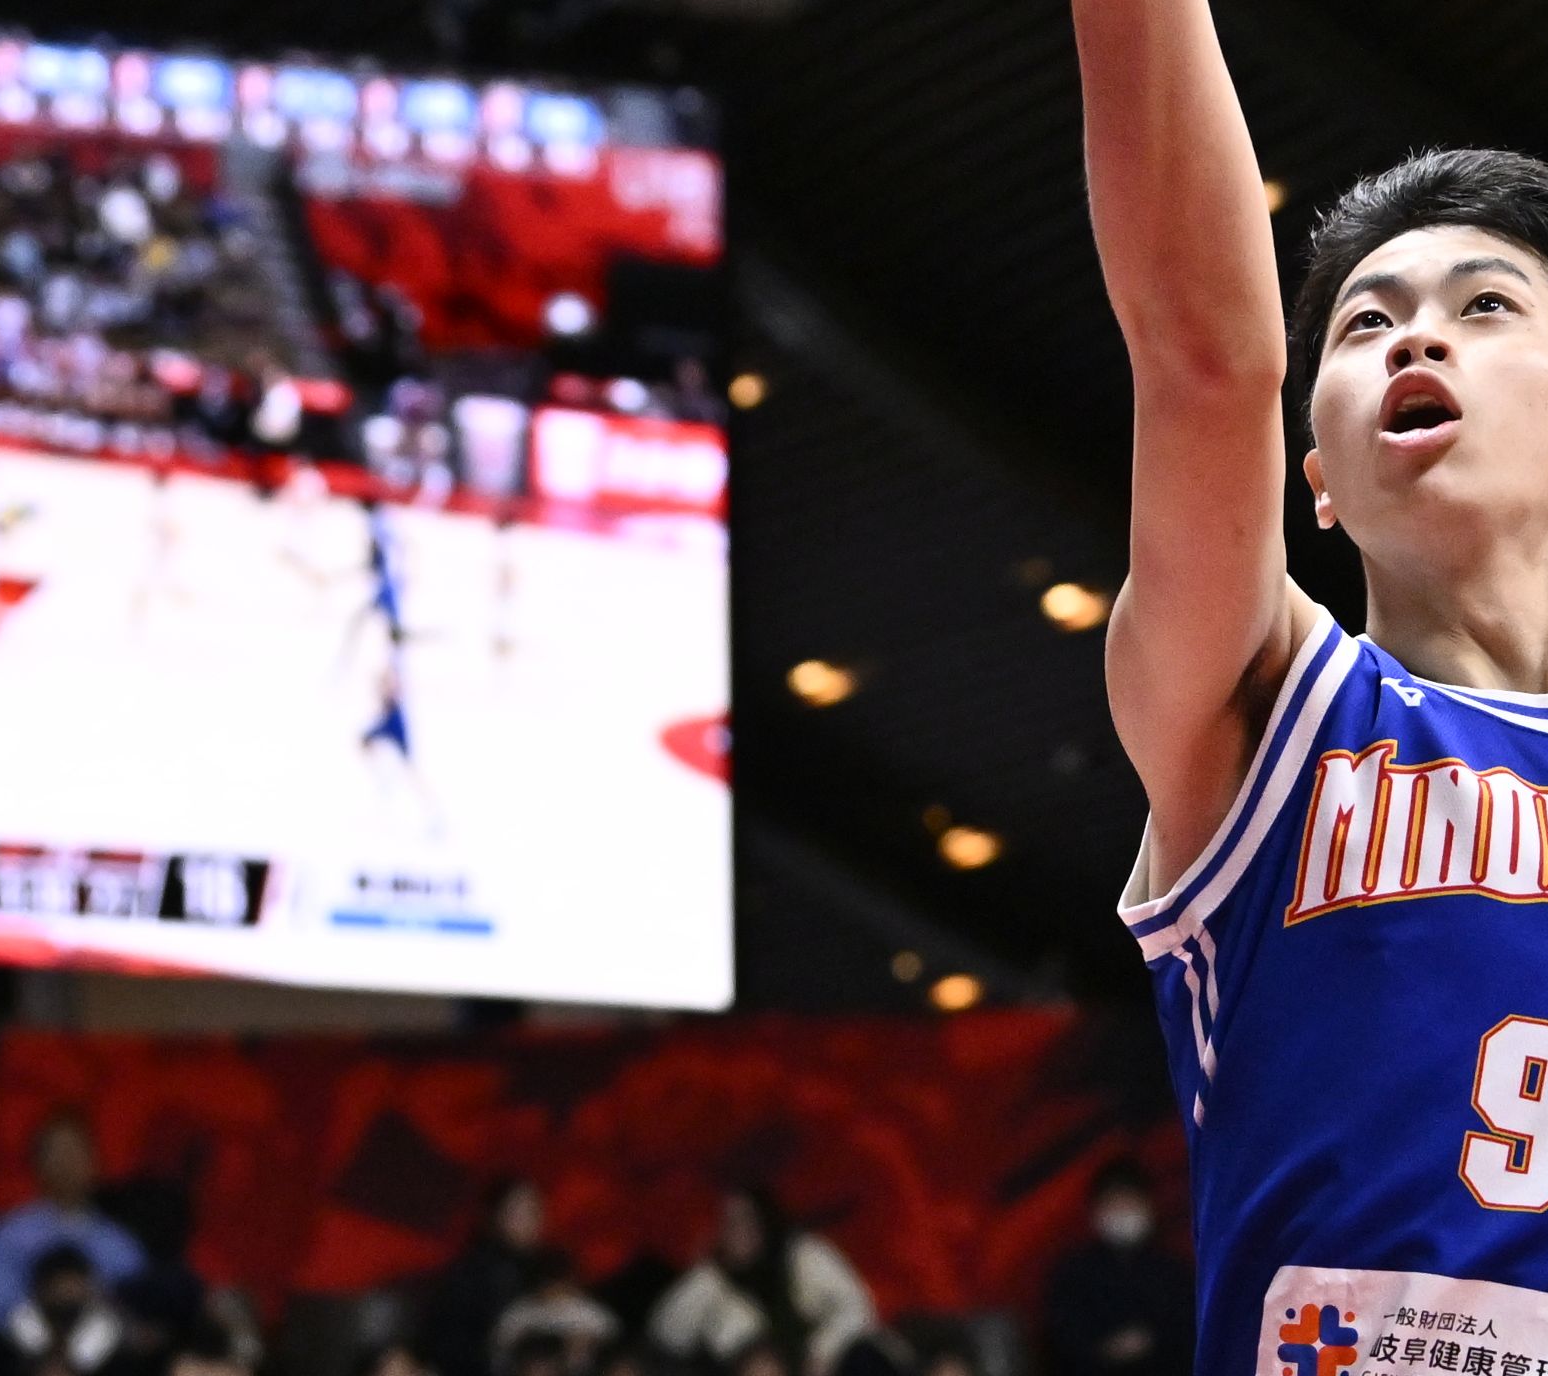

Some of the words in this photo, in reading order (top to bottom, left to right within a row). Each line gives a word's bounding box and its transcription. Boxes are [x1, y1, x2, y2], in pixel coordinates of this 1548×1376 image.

[1382, 1306, 1499, 1340] 一般財団法人
